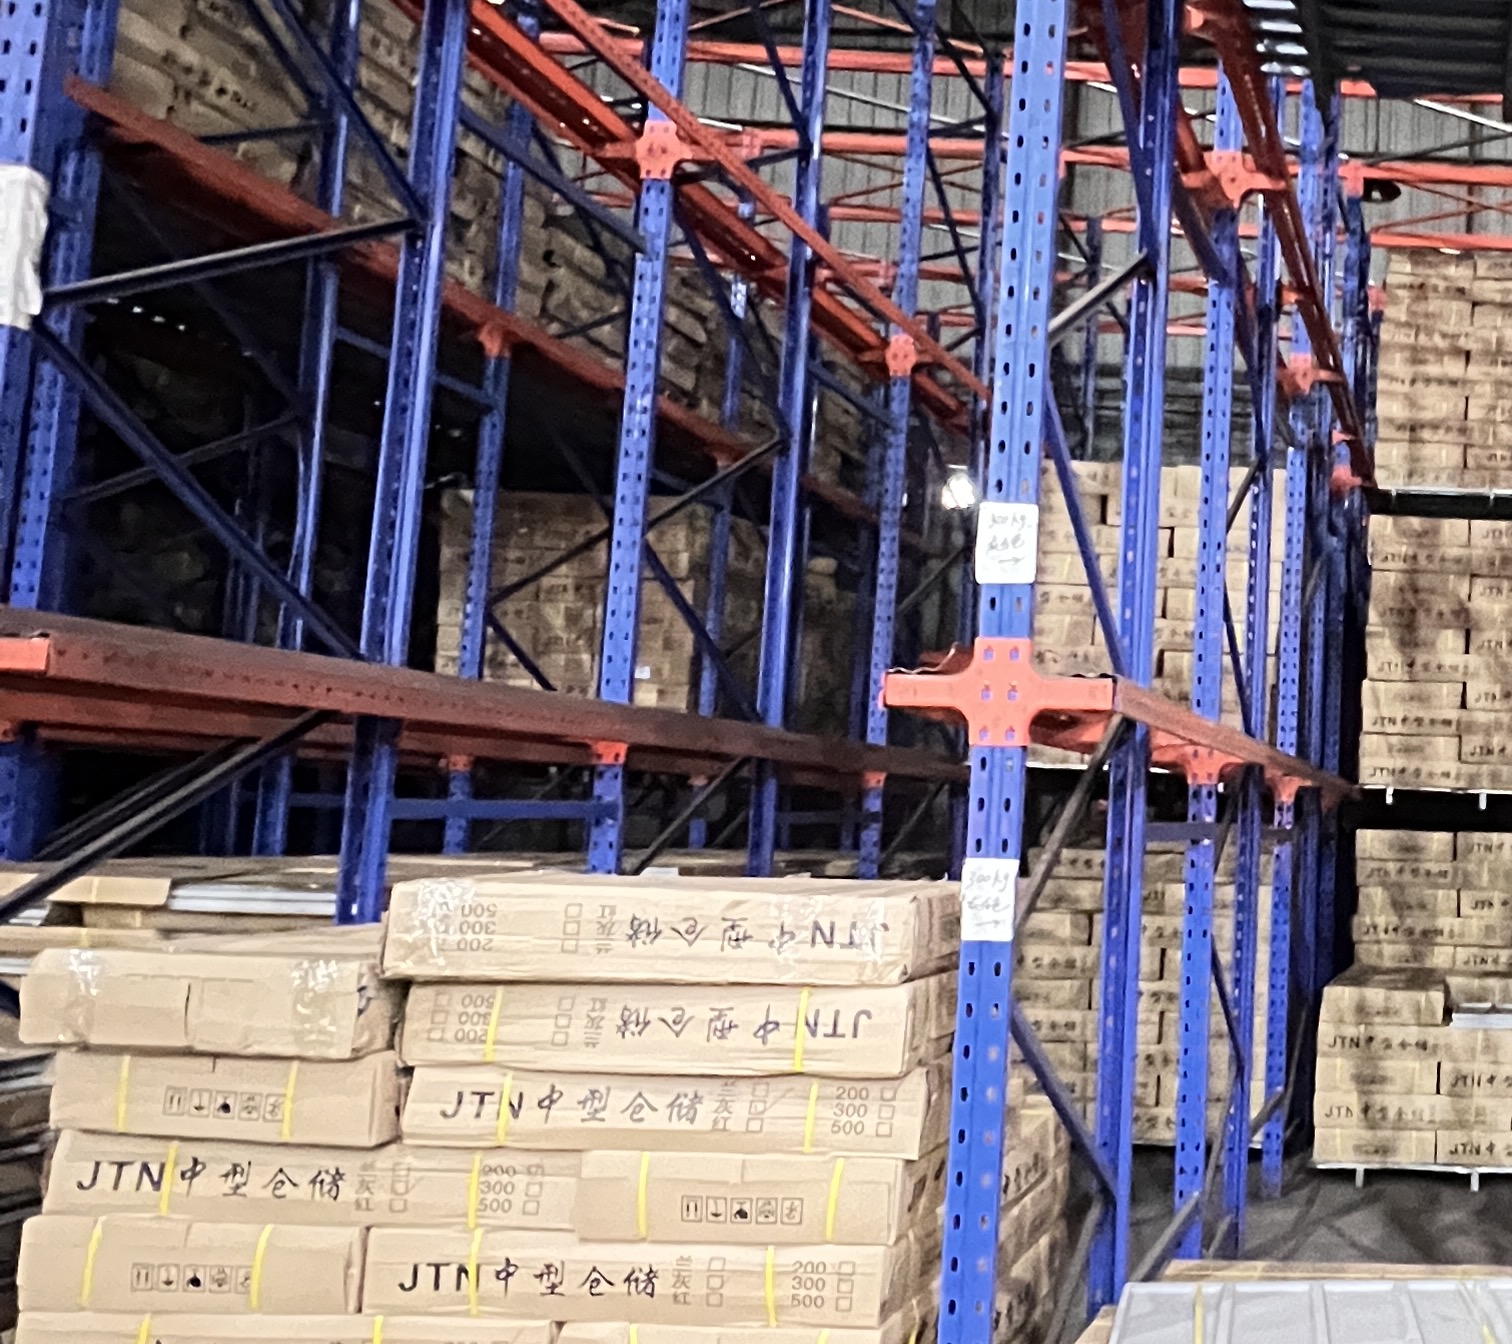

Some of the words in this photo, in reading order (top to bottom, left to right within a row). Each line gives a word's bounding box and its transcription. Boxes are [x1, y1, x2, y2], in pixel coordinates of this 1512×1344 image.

[836, 1086, 869, 1101] 200
[440, 1090, 523, 1120] JTN
[538, 1083, 703, 1125] 中型仓储
[833, 1103, 867, 1118] 300
[831, 1120, 865, 1135] 500
[77, 1161, 163, 1192] JTN
[180, 1157, 346, 1202] 中型仓储
[479, 1181, 515, 1195] 300
[478, 1199, 512, 1213] 500
[793, 1261, 826, 1275] 200
[399, 1263, 479, 1294] JTN
[495, 1257, 661, 1298] 中型仓储
[792, 1276, 825, 1292] 300
[790, 1293, 824, 1309] 500
